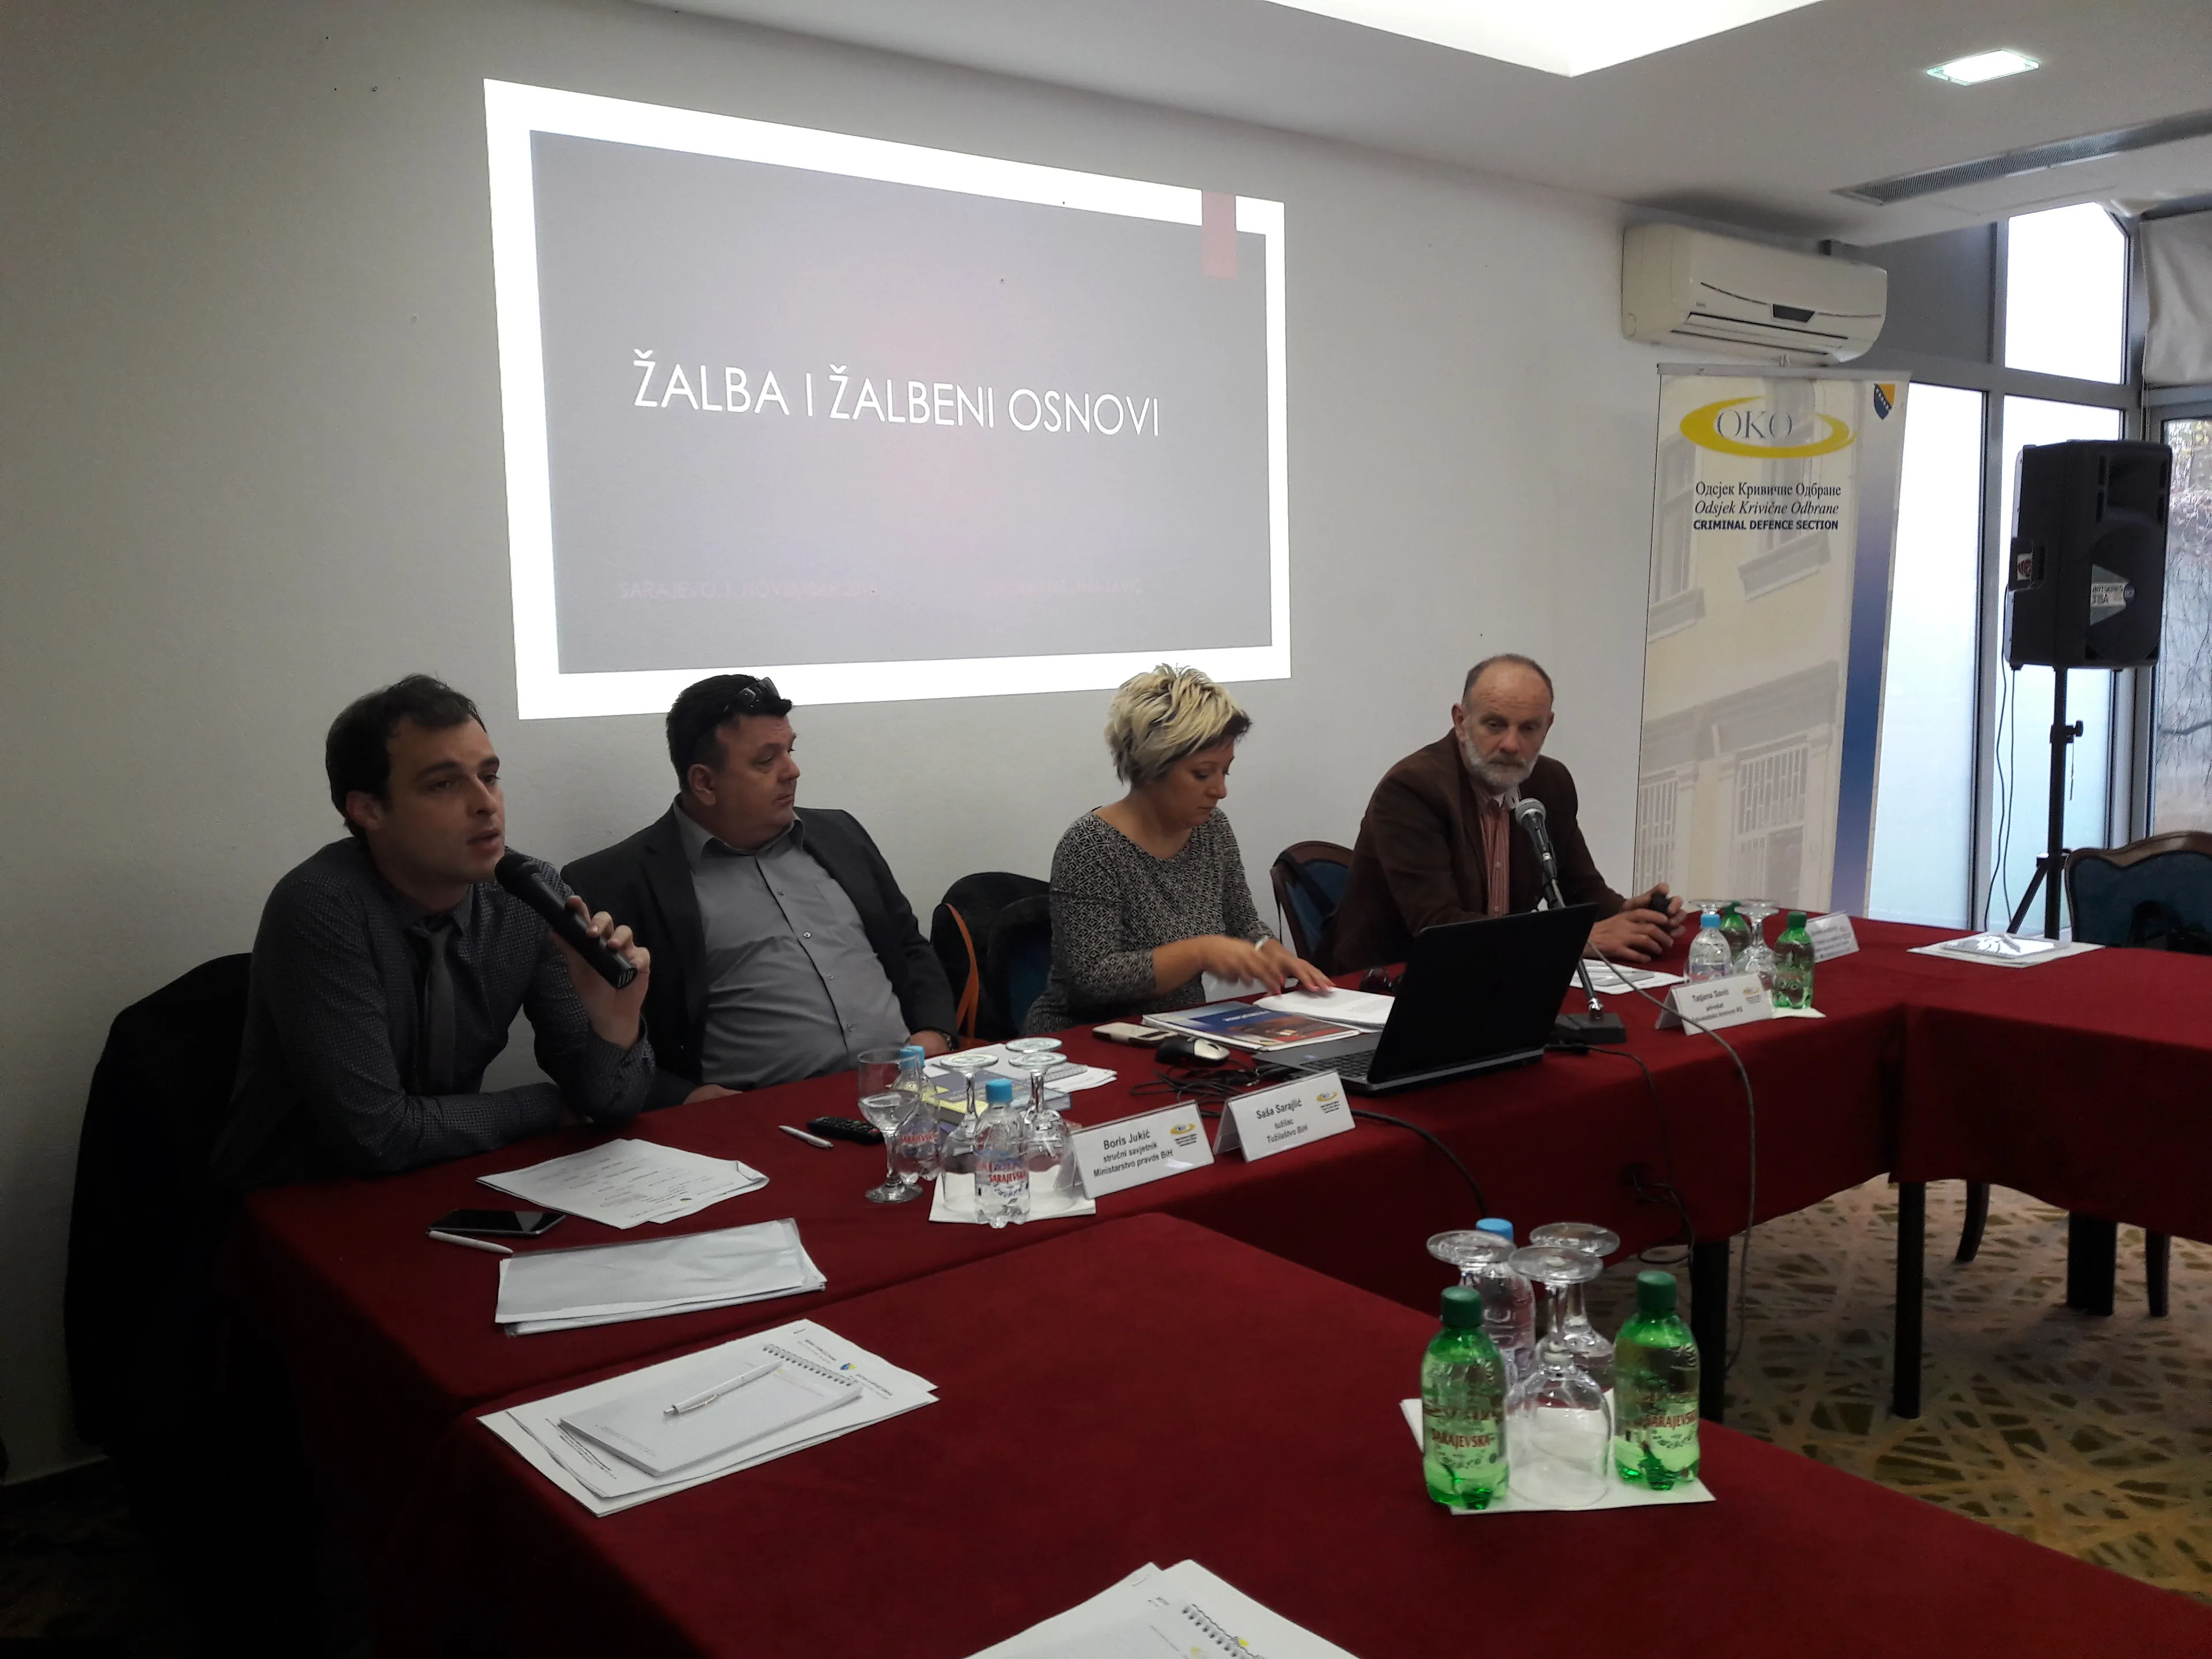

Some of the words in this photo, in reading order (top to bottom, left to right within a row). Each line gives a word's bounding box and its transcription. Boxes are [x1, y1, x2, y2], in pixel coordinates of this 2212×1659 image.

[633, 349, 790, 416] ŽALBA
[806, 372, 814, 416] I
[828, 363, 994, 428] ŽALBENI
[1008, 388, 1160, 436] OSNOVI
[1717, 410, 1793, 438] OKO
[1696, 481, 1734, 499] Одсјек
[1738, 482, 1793, 499] Кривичне
[1796, 483, 1841, 499] Одбране
[1695, 500, 1736, 517] Odsjek
[1738, 501, 1787, 514] Krivične
[1791, 501, 1839, 514] Odbrane
[1694, 520, 1747, 530] CRIMINAL
[1749, 520, 1793, 530] DEFENCE
[1796, 520, 1838, 530] SECTION
[1103, 1137, 1126, 1150] Boris
[1128, 1130, 1151, 1143] Jukić
[1094, 1160, 1135, 1177] Ministarstvo
[1137, 1154, 1159, 1167] pravde
[1161, 1149, 1173, 1159] BiH
